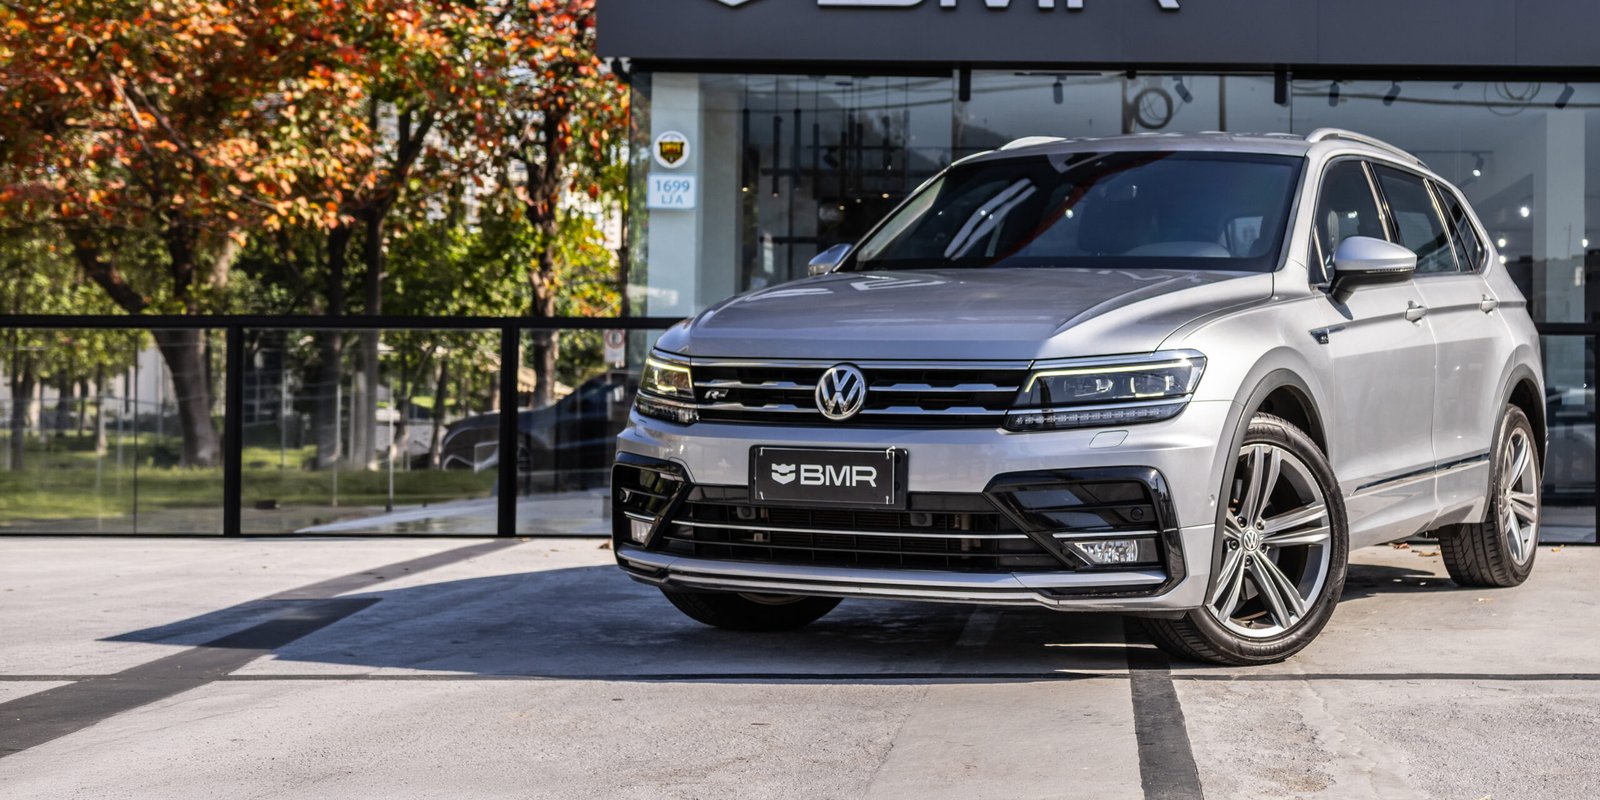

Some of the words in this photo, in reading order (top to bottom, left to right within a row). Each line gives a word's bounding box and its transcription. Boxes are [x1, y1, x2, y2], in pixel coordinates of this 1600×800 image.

[656, 180, 690, 192] 1699
[816, 363, 866, 420] VW
[800, 464, 877, 487] BMR
